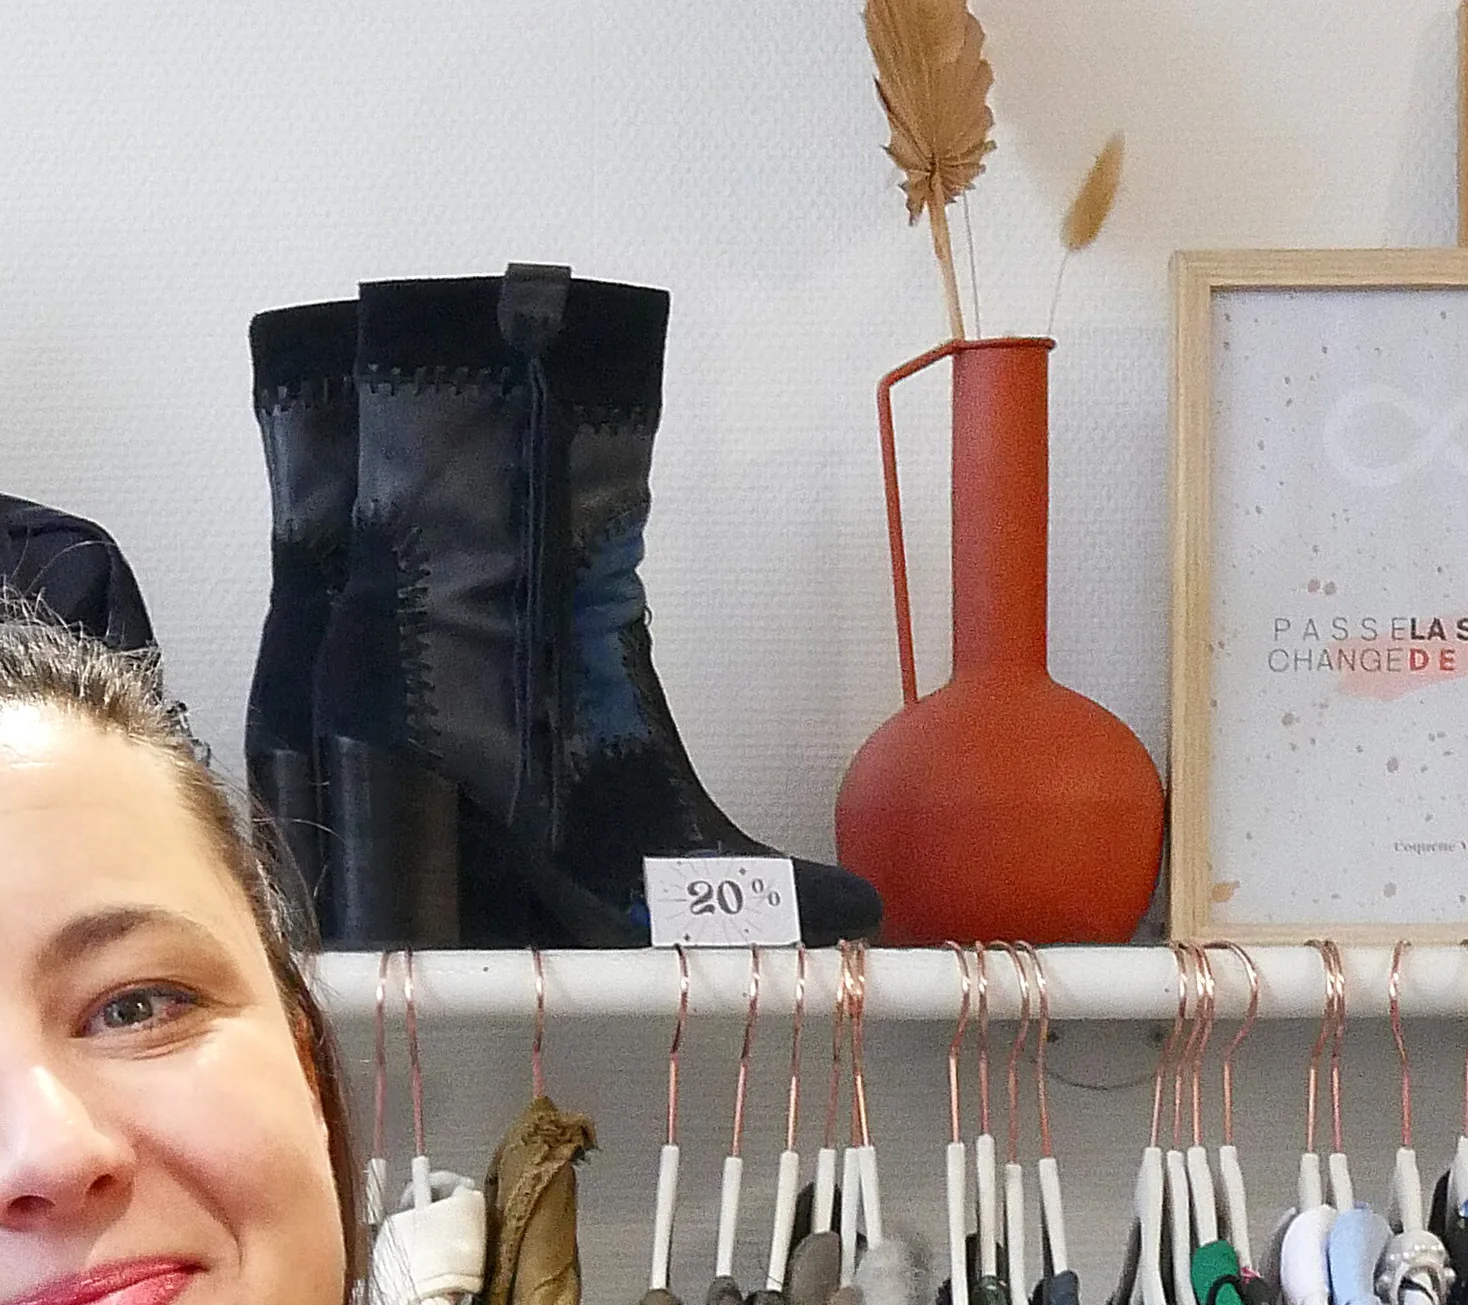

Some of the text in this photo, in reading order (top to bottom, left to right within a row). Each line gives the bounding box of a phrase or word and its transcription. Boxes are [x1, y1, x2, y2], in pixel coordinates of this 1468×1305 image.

[1268, 648, 1455, 672] CHANGE DE
[687, 878, 781, 915] 20%
